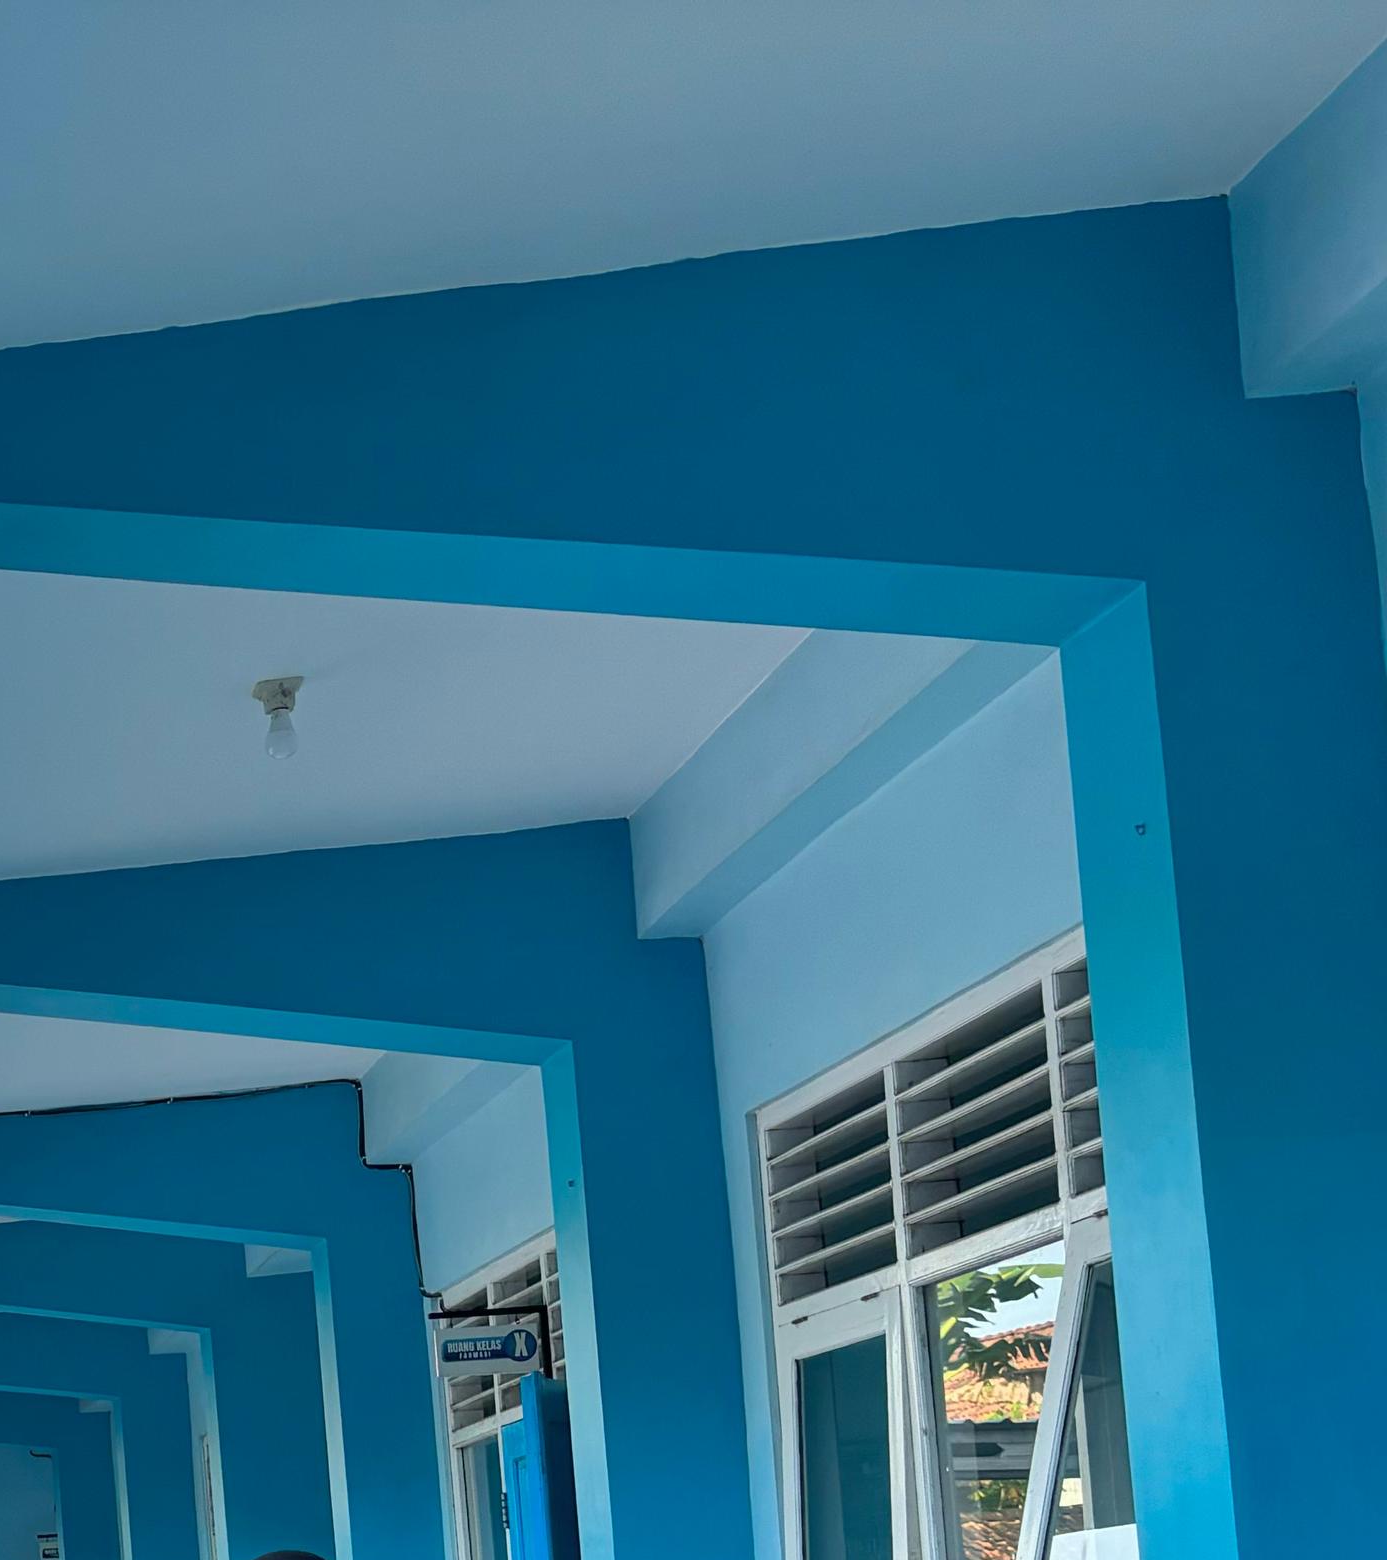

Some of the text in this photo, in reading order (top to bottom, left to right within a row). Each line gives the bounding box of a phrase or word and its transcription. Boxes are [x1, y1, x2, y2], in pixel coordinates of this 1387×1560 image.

[447, 1332, 529, 1357] RUANG KELAS X
